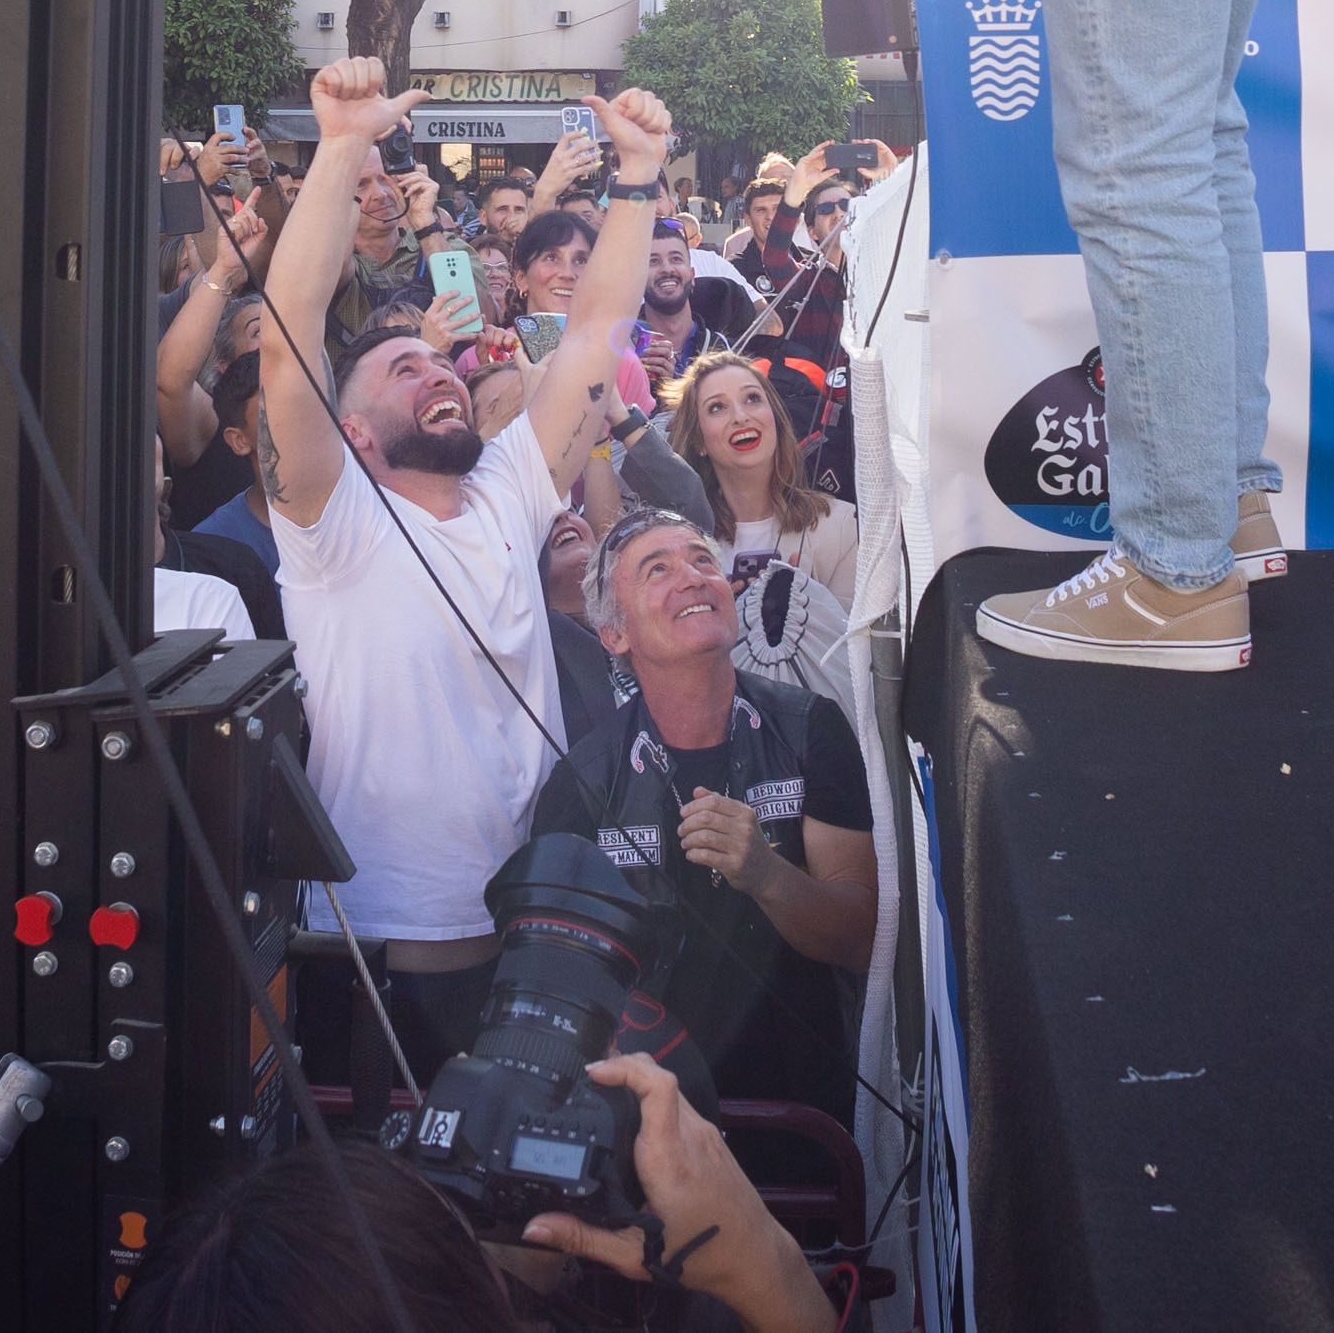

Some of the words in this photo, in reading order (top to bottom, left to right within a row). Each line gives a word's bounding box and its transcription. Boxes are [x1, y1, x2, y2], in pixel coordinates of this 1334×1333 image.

[450, 74, 561, 98] CRISTINA
[428, 121, 506, 139] CRISTINA
[1085, 592, 1109, 609] VANS
[755, 800, 804, 819] ORIGINA
